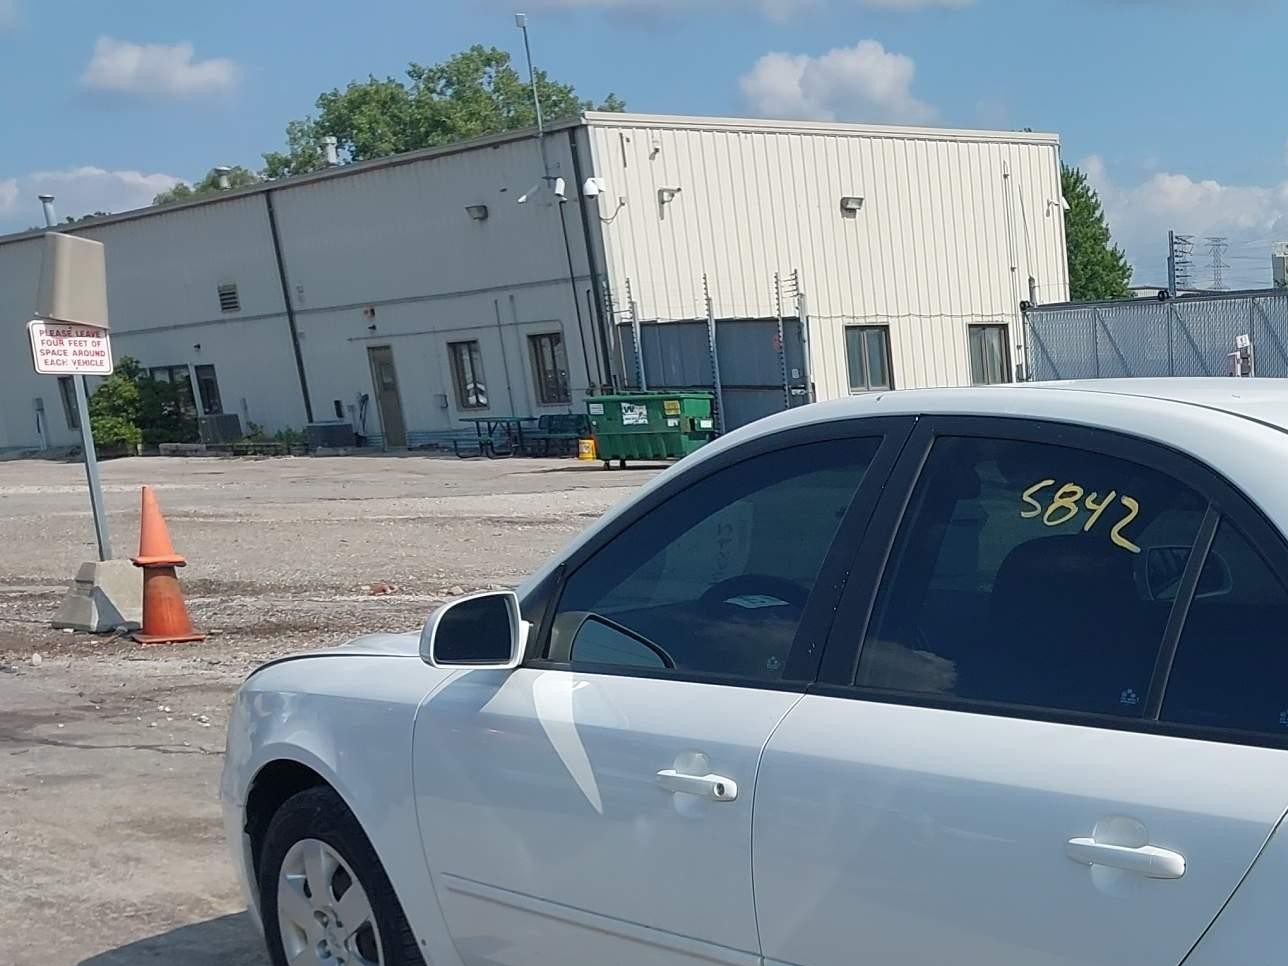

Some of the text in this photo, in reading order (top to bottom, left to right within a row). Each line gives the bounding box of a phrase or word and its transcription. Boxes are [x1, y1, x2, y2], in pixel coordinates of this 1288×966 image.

[39, 329, 101, 338] PLEASE LEAVE
[41, 339, 65, 347] FOUR
[39, 349, 68, 357] SPACE
[71, 359, 104, 367] VEHICLE
[1020, 479, 1141, 553] 5842
